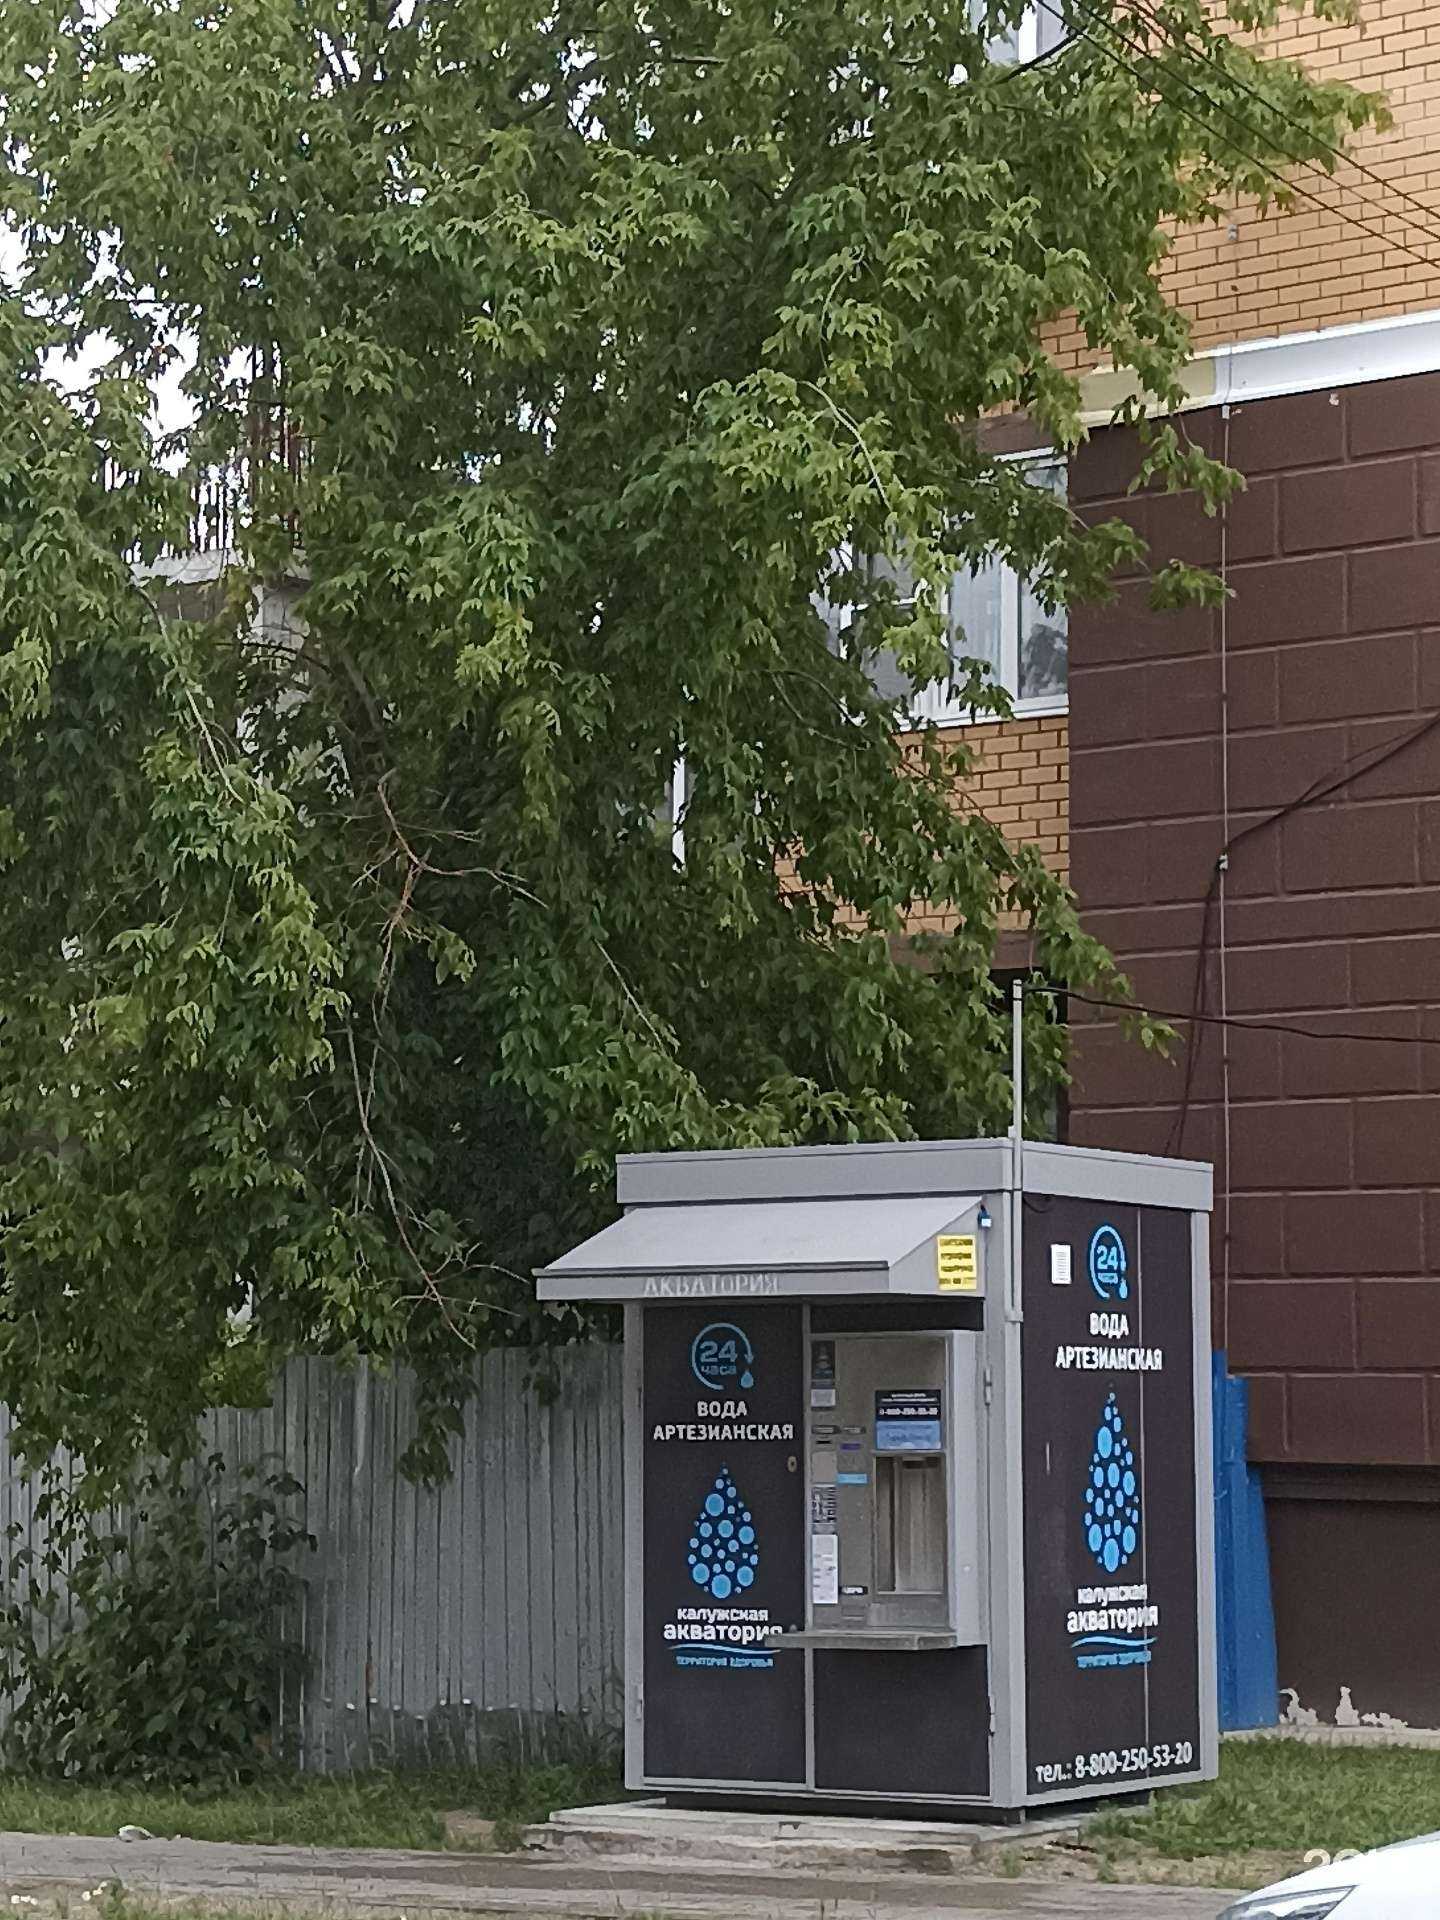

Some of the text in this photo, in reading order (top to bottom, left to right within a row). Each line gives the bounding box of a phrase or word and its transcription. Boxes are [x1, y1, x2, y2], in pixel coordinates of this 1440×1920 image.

[1096, 1244, 1119, 1270] 24
[643, 1273, 778, 1297] АКВАТОРИЯ
[1089, 1312, 1130, 1339] ВОДА
[699, 1340, 738, 1363] 24
[1055, 1345, 1163, 1371] АРТЕЗИАНСКАЯ
[697, 1400, 748, 1419] ВОДА
[653, 1424, 794, 1440] АРТЕЗИАНСКАЯ
[676, 1608, 769, 1624] калужская
[1066, 1605, 1159, 1633] акватория
[1075, 1741, 1193, 1779] 8-800-250-53-20
